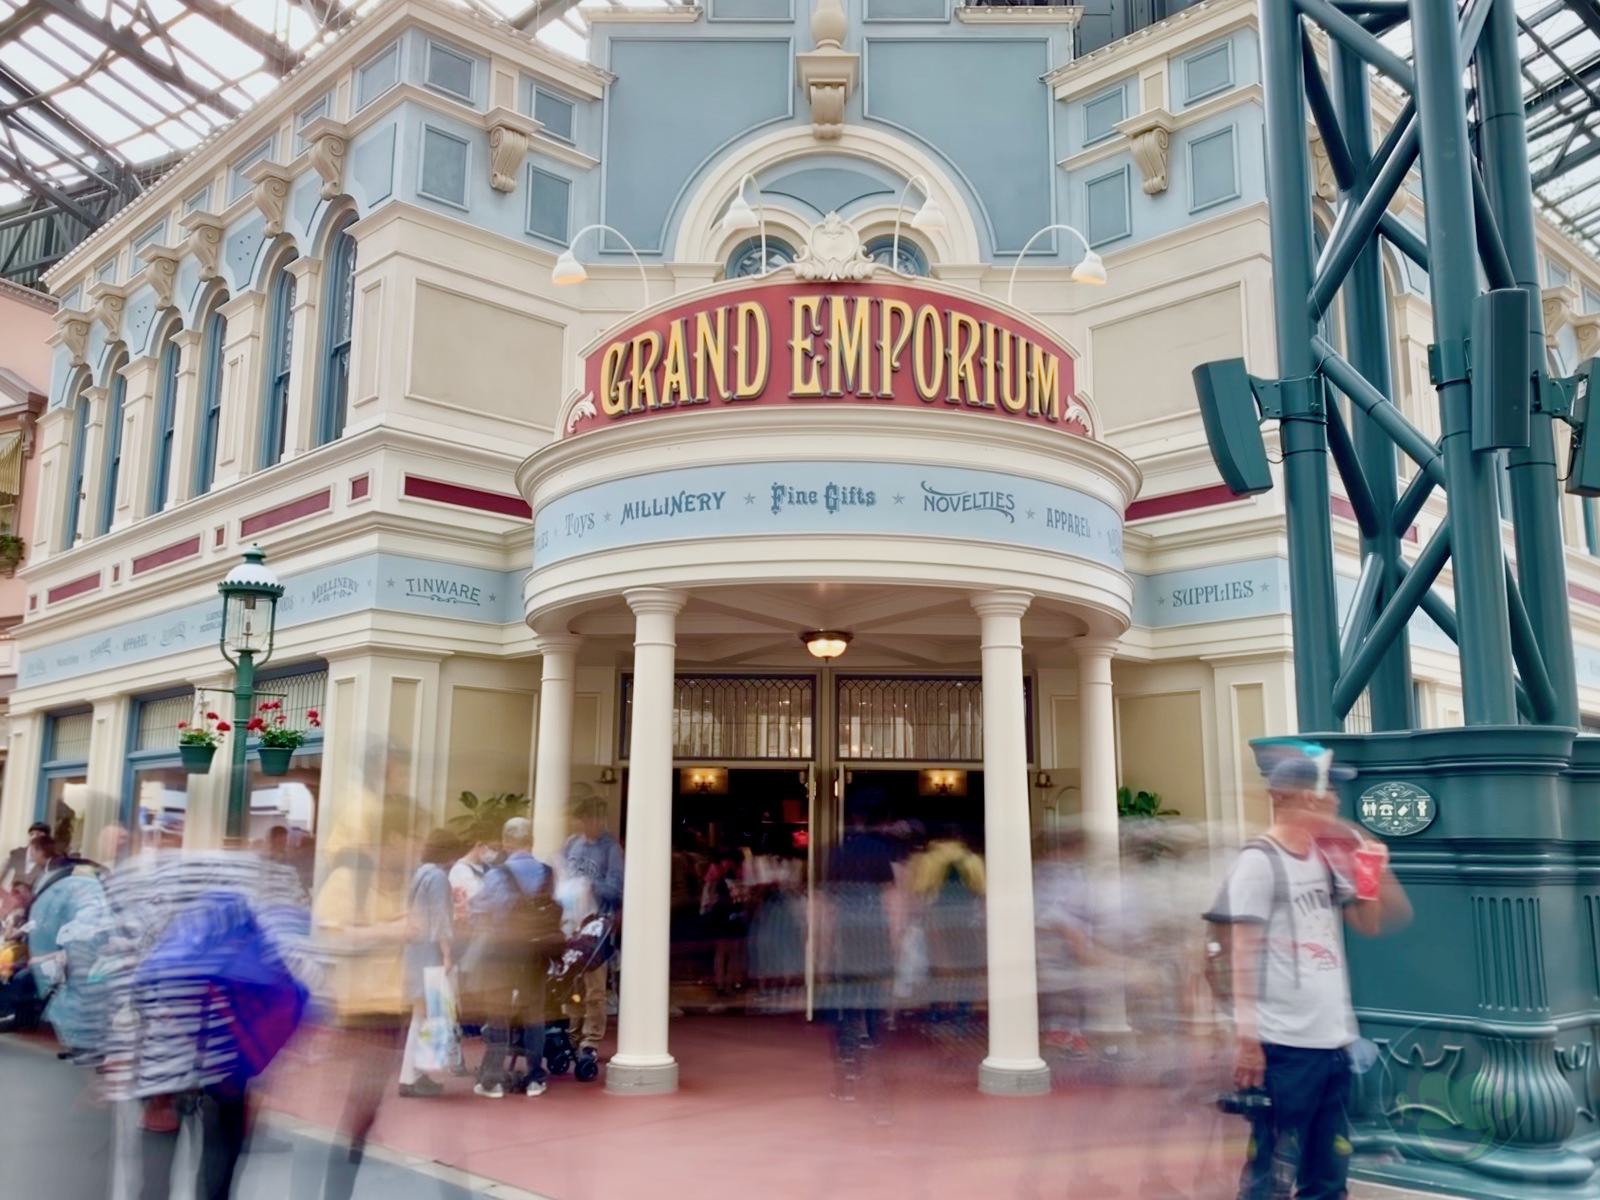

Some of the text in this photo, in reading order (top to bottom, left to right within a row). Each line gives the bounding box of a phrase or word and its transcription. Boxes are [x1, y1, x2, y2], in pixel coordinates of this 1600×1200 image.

[600, 295, 1061, 422] GRAND EMPORIUM
[564, 481, 1091, 538] Toys MILLINERY Fine Gifts NOVELTIES APPAREL
[405, 578, 481, 602] TINWARE
[1172, 579, 1255, 608] SUPPLIES
